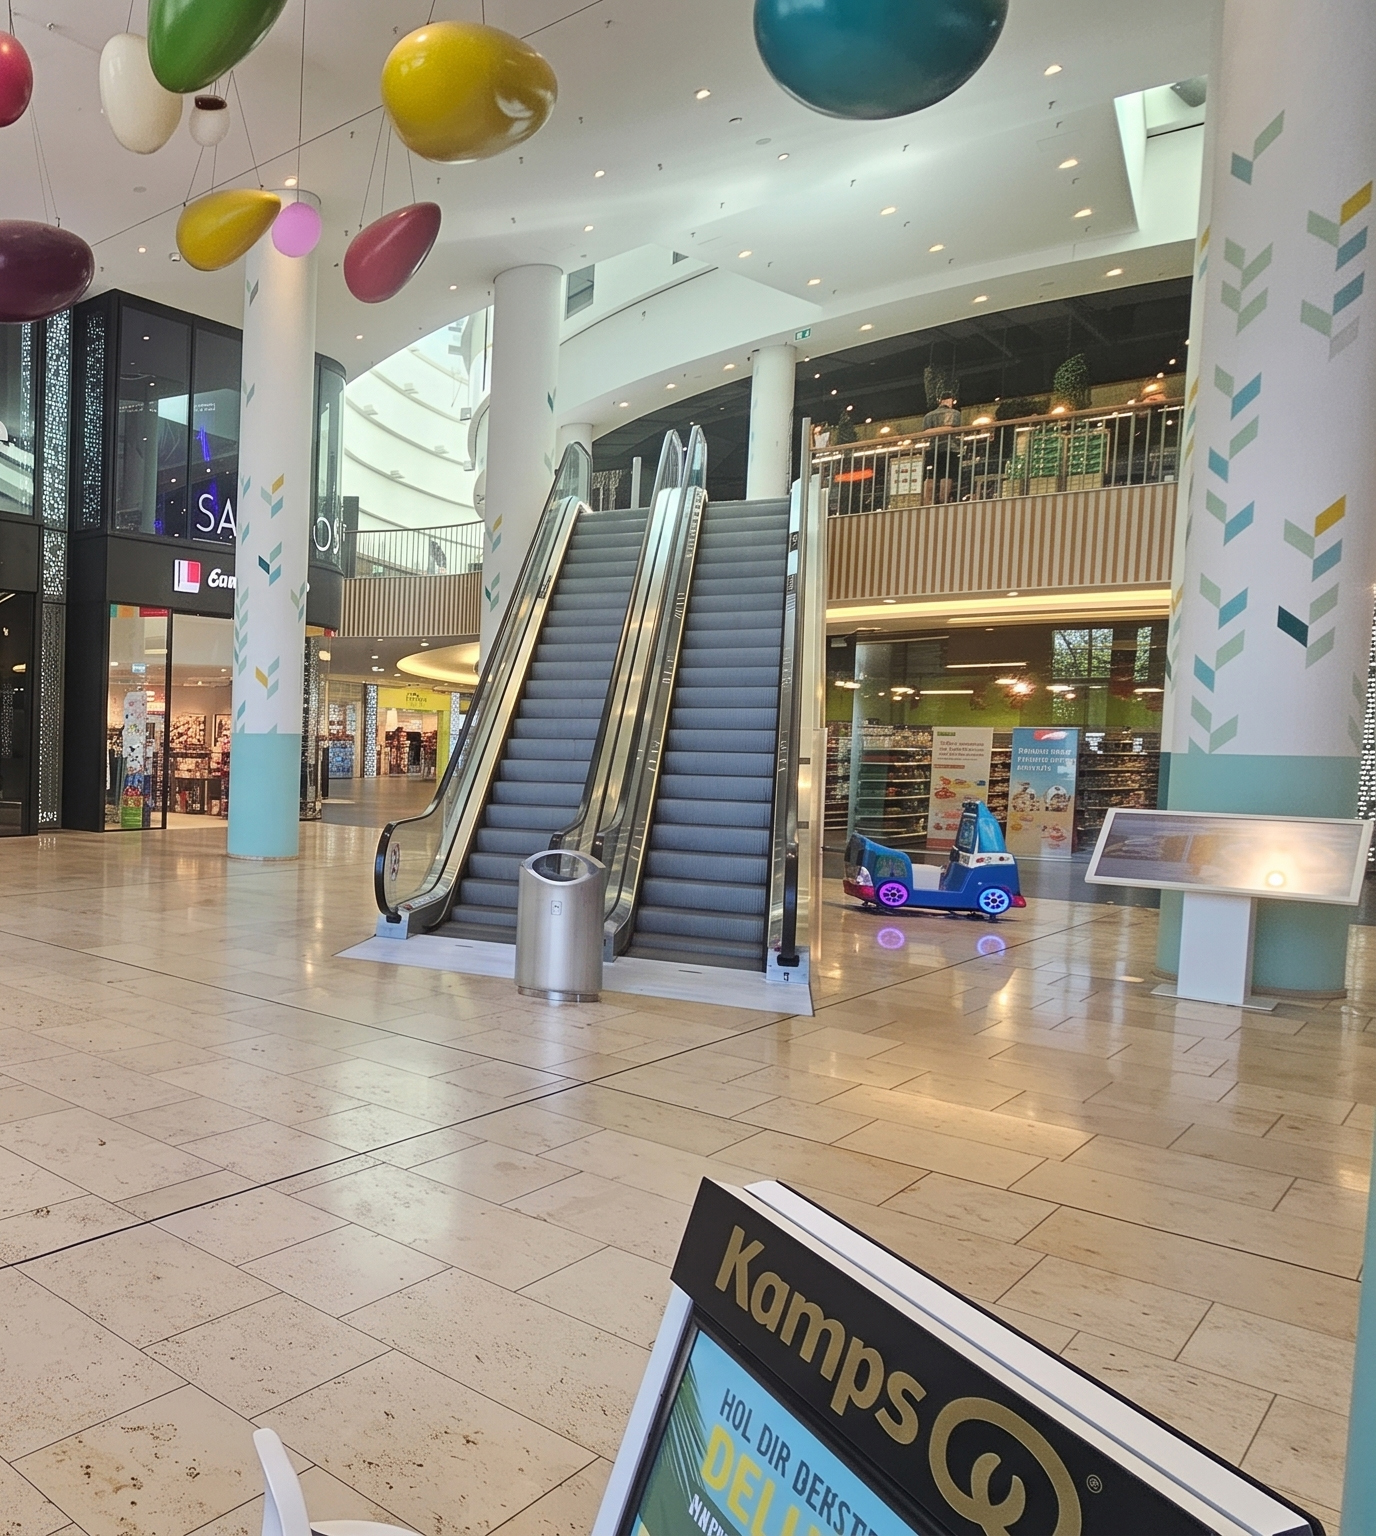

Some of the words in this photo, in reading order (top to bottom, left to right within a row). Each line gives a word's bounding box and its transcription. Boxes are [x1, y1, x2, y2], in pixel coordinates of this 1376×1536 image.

[714, 1224, 927, 1445] Kamps
[719, 1387, 753, 1444] HOL
[756, 1423, 790, 1478] DIR
